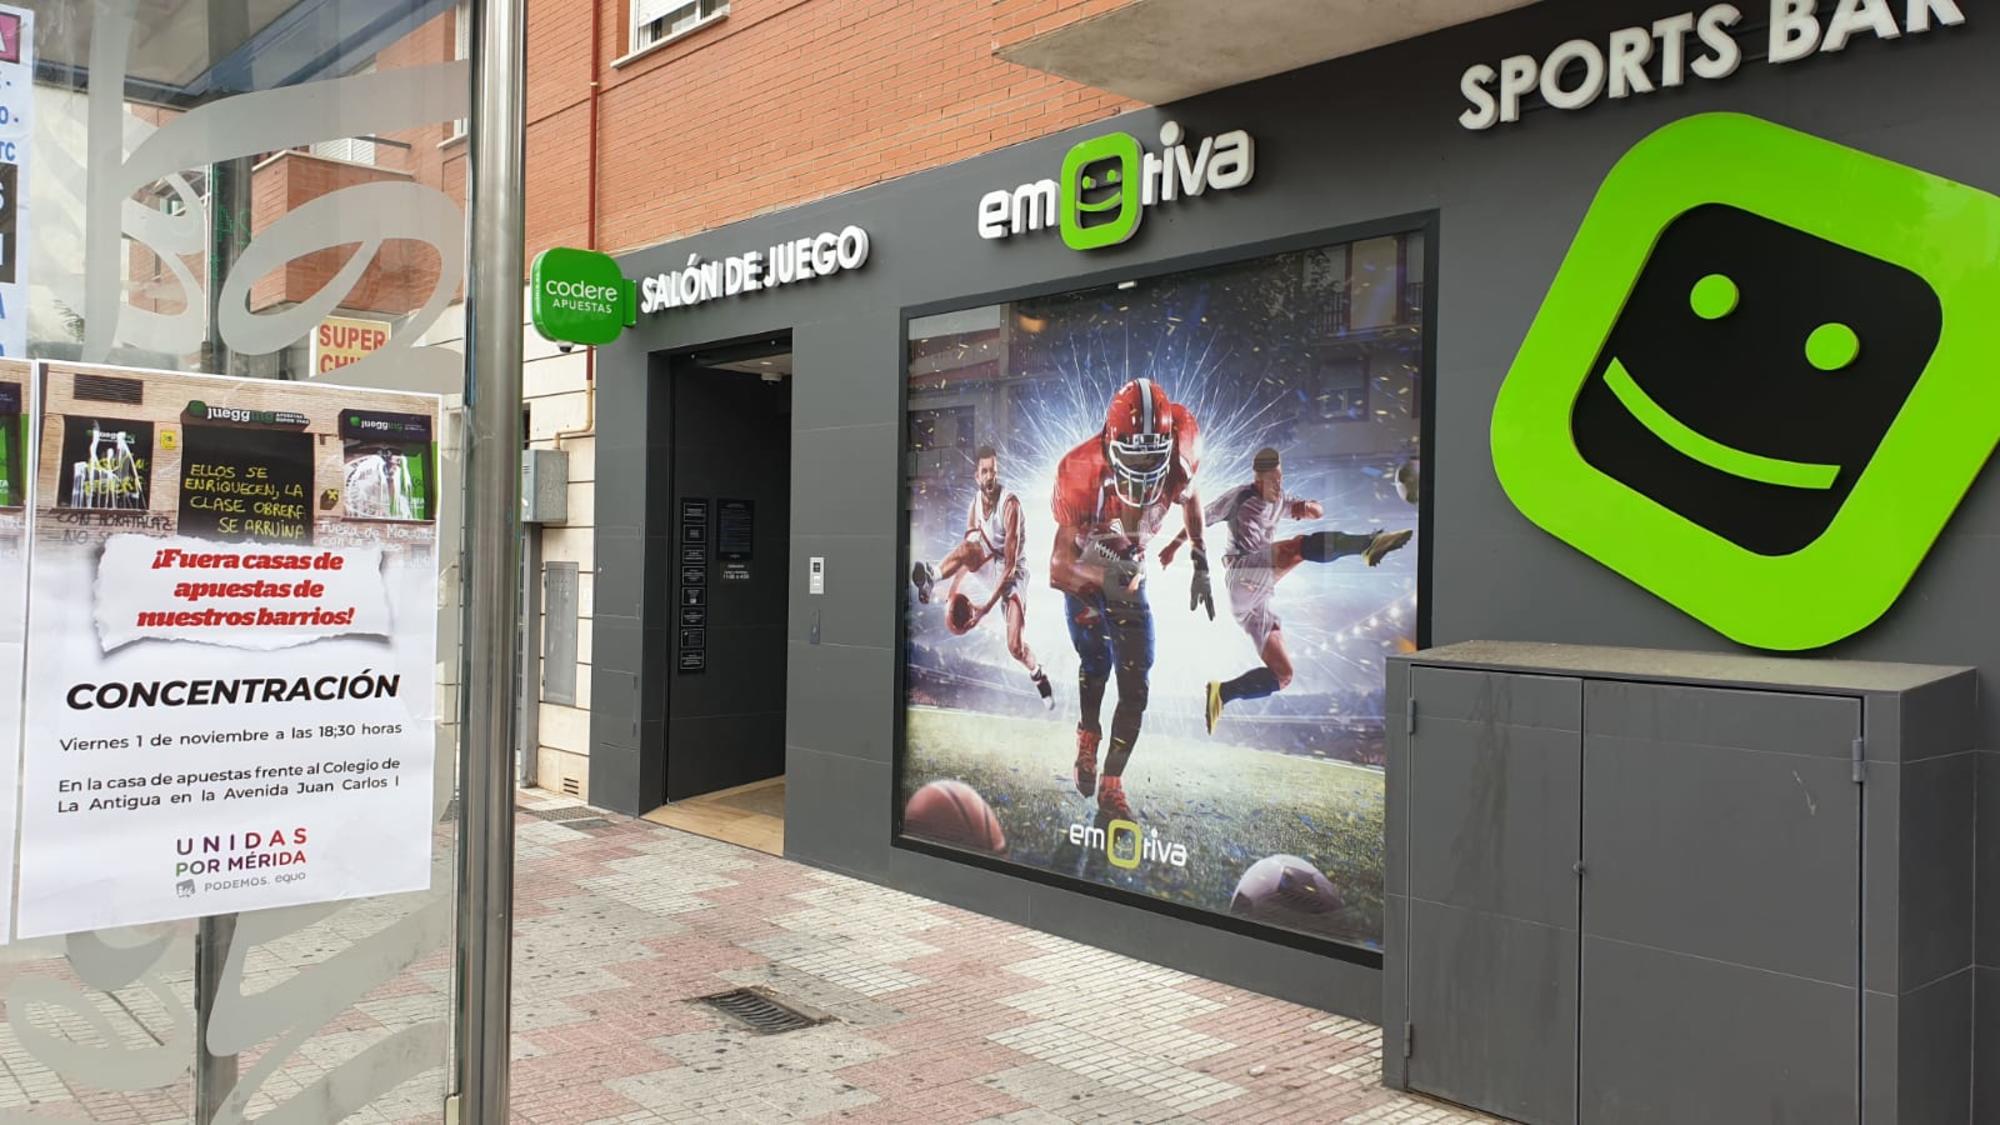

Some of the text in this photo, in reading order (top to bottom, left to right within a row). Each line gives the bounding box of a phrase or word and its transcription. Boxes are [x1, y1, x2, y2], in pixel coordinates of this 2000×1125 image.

[1458, 3, 1742, 130] SPORTS
[641, 225, 870, 313] SALÓN DE JUEGO
[546, 279, 618, 302] codere
[552, 298, 612, 314] APUESTAS
[319, 324, 386, 351] SUPER
[190, 464, 268, 478] ELLOS SE
[284, 484, 304, 498] LA
[190, 496, 246, 513] CLASE
[217, 516, 239, 533] SE
[152, 548, 344, 570] ¡Fuera casas de
[173, 579, 324, 601] apuestas de
[136, 606, 355, 627] nuestros barrios!
[66, 668, 400, 711] CONCENTRACIÓN
[60, 737, 129, 751] Viernes
[136, 735, 142, 748] 1
[150, 733, 172, 747] de
[180, 729, 269, 745] noviembre
[275, 730, 285, 740] a
[291, 727, 313, 739] las
[361, 722, 402, 735] horas
[59, 757, 401, 793] En la casa de apuestas frente al Colegio de
[58, 801, 79, 813] La
[89, 795, 161, 811] Antigua
[170, 793, 192, 804] en
[201, 790, 216, 801] la
[224, 784, 289, 800] Avenida
[296, 781, 334, 794] Juan
[342, 777, 388, 790] Carlos
[176, 827, 307, 856] UNIDAS
[175, 850, 306, 877] POR MÉRIDA
